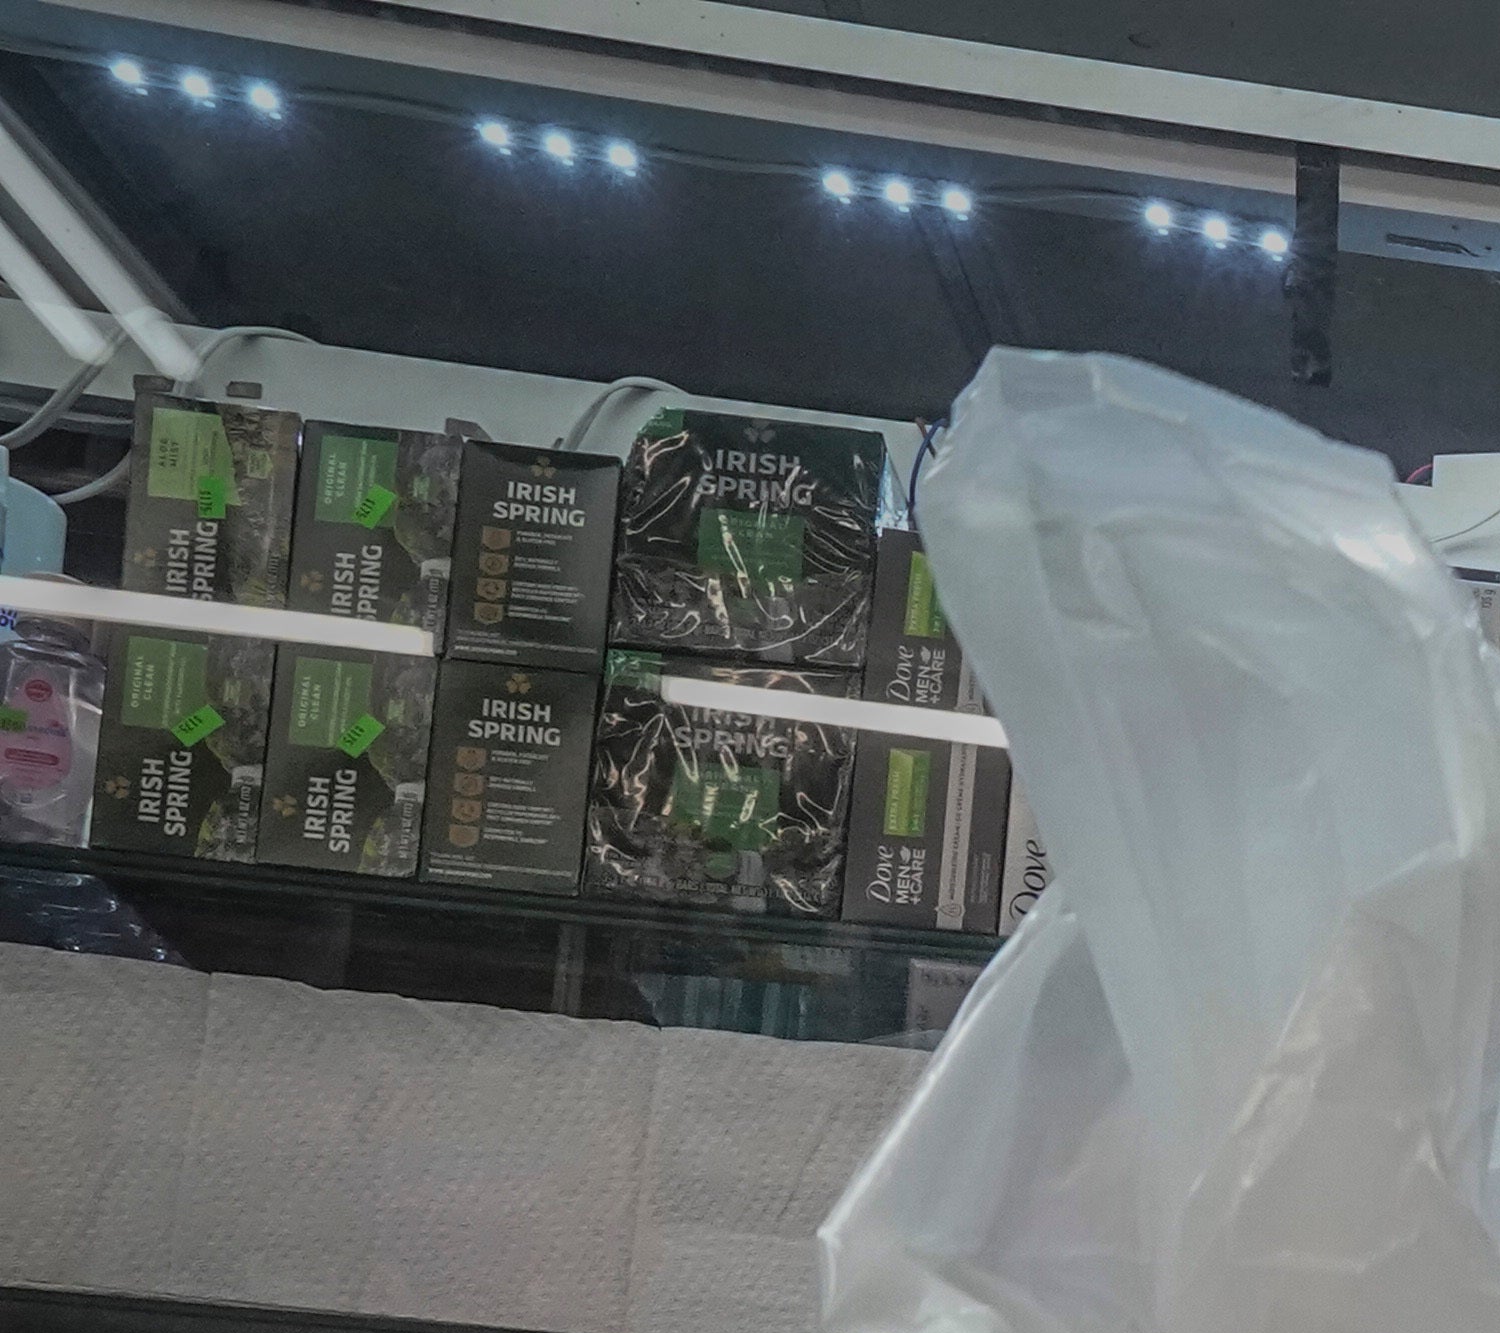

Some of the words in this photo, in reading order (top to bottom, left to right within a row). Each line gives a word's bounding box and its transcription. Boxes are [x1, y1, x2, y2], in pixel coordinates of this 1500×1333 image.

[715, 449, 801, 477] IRISH
[492, 500, 587, 528] SPRING
[507, 480, 577, 506] IRISH
[699, 473, 813, 506] SPRING
[165, 528, 191, 594] IRISH
[331, 551, 357, 615] IRISH
[886, 645, 916, 703] Dove
[915, 665, 931, 704] MEN
[467, 719, 562, 747] SPRING
[481, 698, 552, 724] IRISH
[674, 726, 792, 759] SPRING
[137, 757, 166, 824] IRISH
[164, 749, 194, 838] SPRING
[303, 776, 331, 841] IRISH
[328, 767, 359, 854] SPRING
[865, 844, 895, 905] Dove
[895, 865, 912, 905] MEN
[910, 847, 927, 905] +CARE
